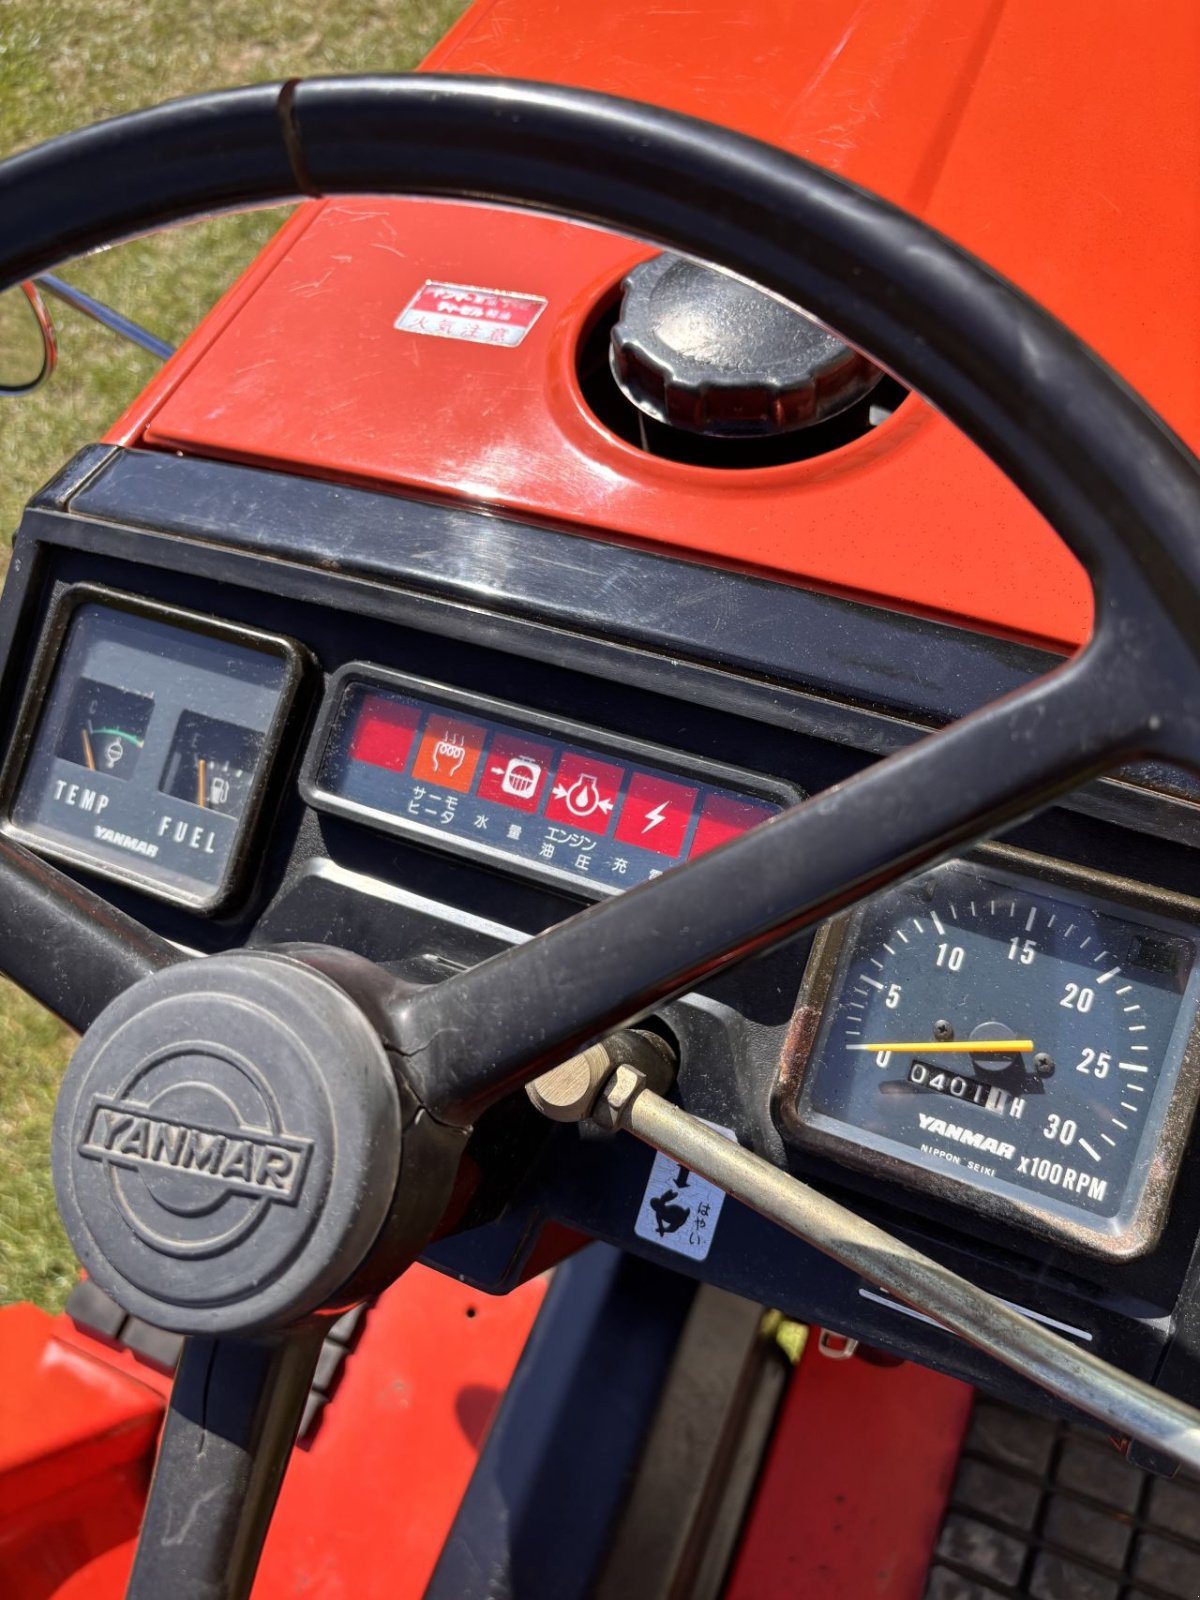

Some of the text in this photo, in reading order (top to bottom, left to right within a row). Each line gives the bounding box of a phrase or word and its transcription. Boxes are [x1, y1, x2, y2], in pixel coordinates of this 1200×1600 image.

[54, 780, 110, 814] TEMP
[407, 799, 455, 824] ヒータ
[413, 785, 459, 809] サーモ
[94, 825, 159, 858] YANMAR
[157, 816, 215, 854] FUEL
[545, 826, 597, 851] エンジン
[936, 943, 965, 971] 10
[1007, 936, 1037, 965] 15
[885, 984, 901, 1009] 5
[1060, 982, 1095, 1013] 20
[1076, 1048, 1111, 1079] 25
[1009, 1096, 1026, 1119] H
[918, 1112, 1017, 1160] YANMAR
[1043, 1113, 1078, 1146] 30
[104, 1110, 293, 1190] YANMAR
[920, 1143, 996, 1178] NIPPON SEIKI
[689, 1201, 711, 1245] はやい
